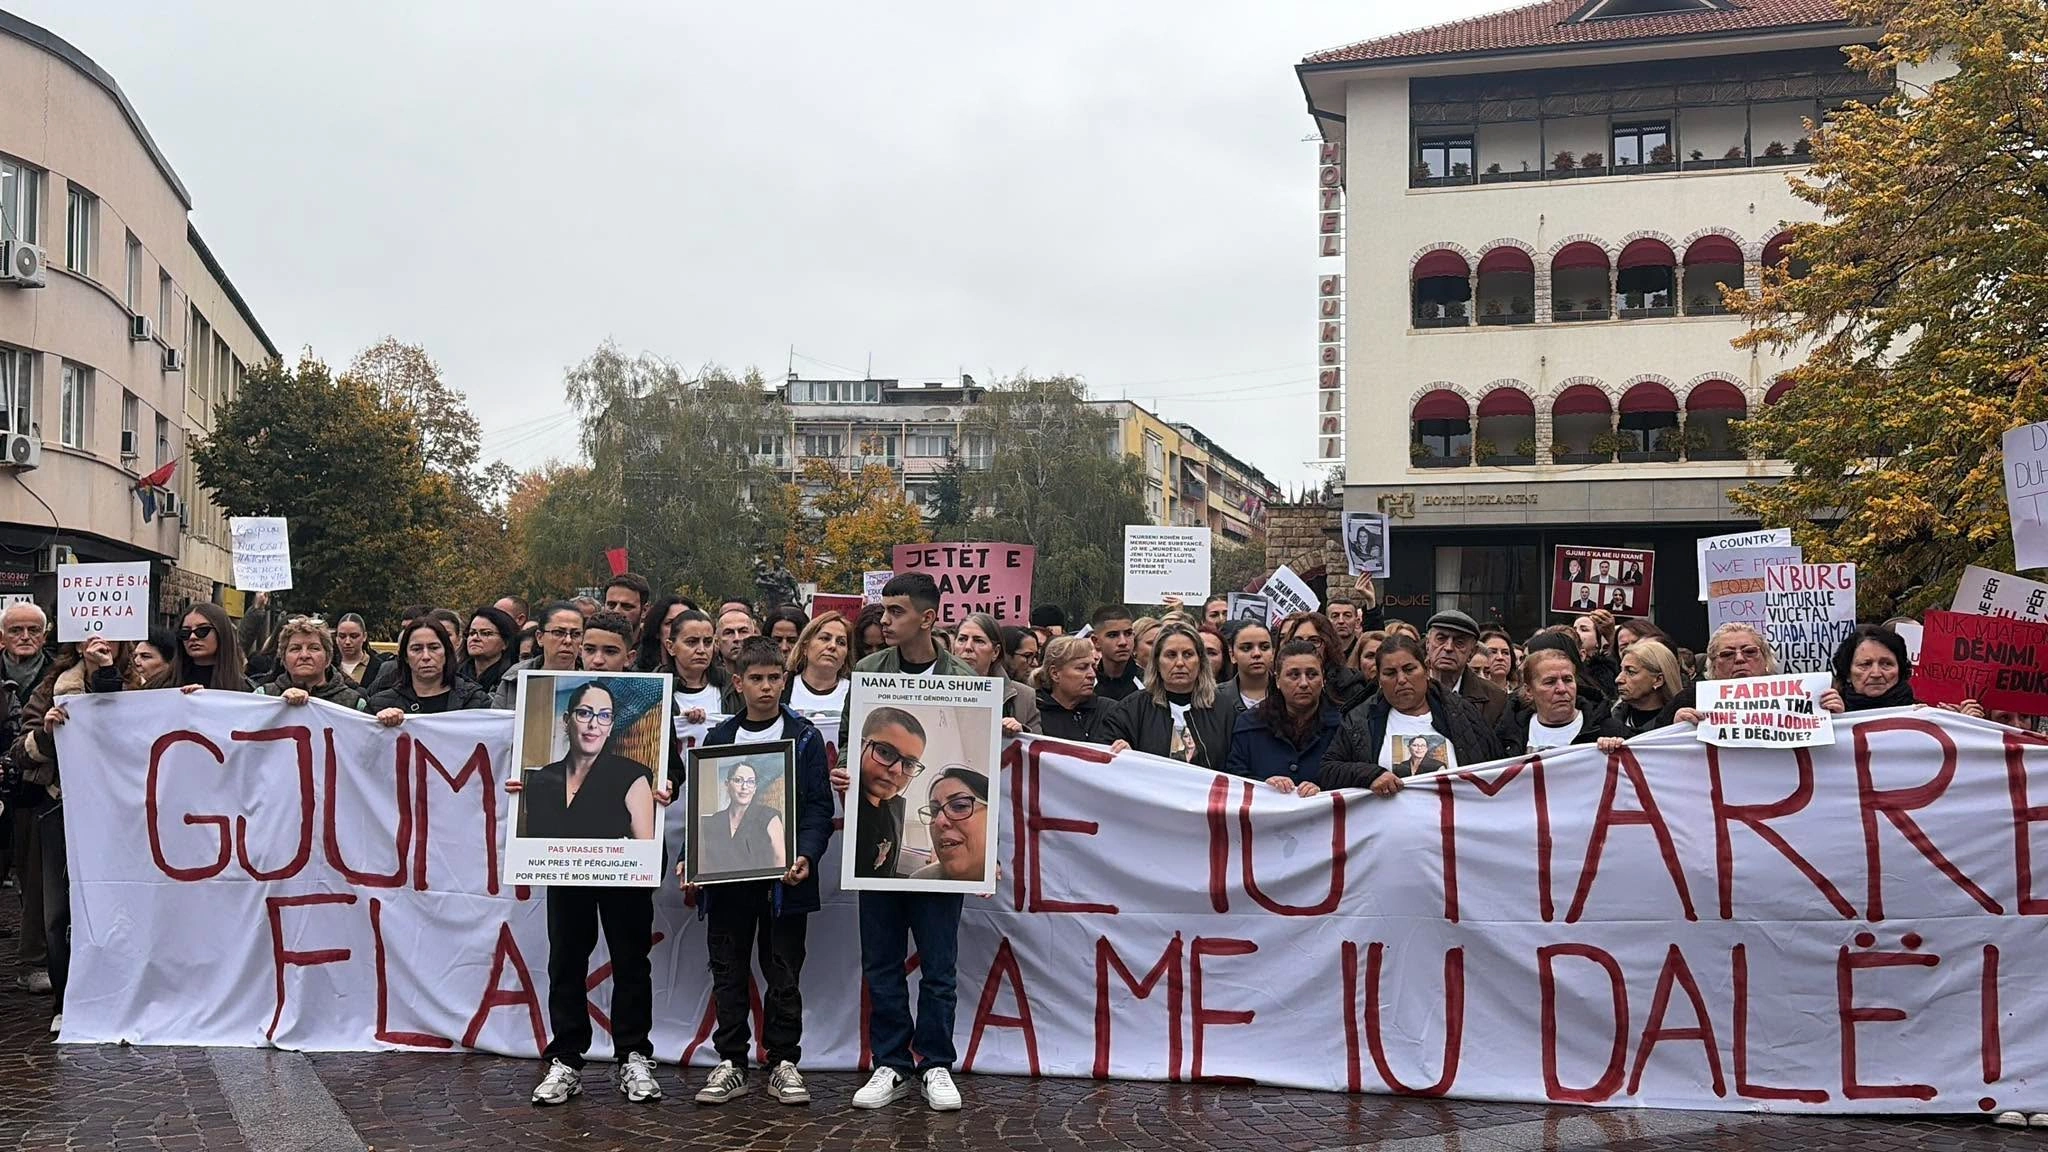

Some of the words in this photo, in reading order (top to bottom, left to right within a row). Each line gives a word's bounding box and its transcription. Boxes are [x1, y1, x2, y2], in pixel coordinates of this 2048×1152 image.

[1320, 143, 1340, 257] HOTEL
[1709, 541, 1717, 550] A
[1719, 533, 1776, 549] COUNTRY
[905, 544, 990, 568] JETËT
[1006, 550, 1021, 568] E
[1712, 558, 1744, 573] WE
[63, 573, 149, 588] DREJTËSIA
[937, 574, 991, 595] AVE
[1720, 578, 1765, 594] TODA
[1767, 565, 1852, 592] N'BURG
[77, 591, 128, 602] VONOI
[1766, 591, 1836, 607] LUMTURIJE
[70, 606, 133, 617] VDEKJA
[1718, 600, 1757, 618] FOR
[1768, 606, 1830, 625] VUÇETAJ
[84, 621, 103, 632] JO
[1766, 622, 1807, 643] SUADA
[1932, 614, 1969, 639] NUK
[1768, 642, 1832, 660] MIGJEN
[861, 677, 896, 688] NANA
[899, 678, 915, 689] TE
[919, 679, 945, 690] DUA
[948, 680, 992, 692] SHUMË
[1719, 679, 1811, 699] FARUK,
[1713, 700, 1781, 710] ARLINDA
[1785, 698, 1814, 715] THA
[1742, 712, 1773, 726] JAM
[1718, 728, 1727, 740] A
[1732, 728, 1740, 739] E
[1744, 726, 1812, 742] DËGJOVE?
[146, 725, 530, 900] GJUM
[1001, 738, 1118, 914] E
[1208, 775, 1350, 916] IU
[548, 845, 564, 853] PAS
[605, 846, 625, 854] TIME
[548, 859, 570, 867] PRES
[572, 858, 582, 867] TË
[584, 859, 638, 867] PËRGJIGJENI
[560, 872, 570, 881] TË
[572, 873, 590, 881] MOS
[592, 873, 617, 881] MUND
[618, 873, 629, 881] TË
[1091, 928, 1260, 1085] ME
[1342, 942, 1464, 1100] IU
[1538, 931, 2000, 1113] DALË!
